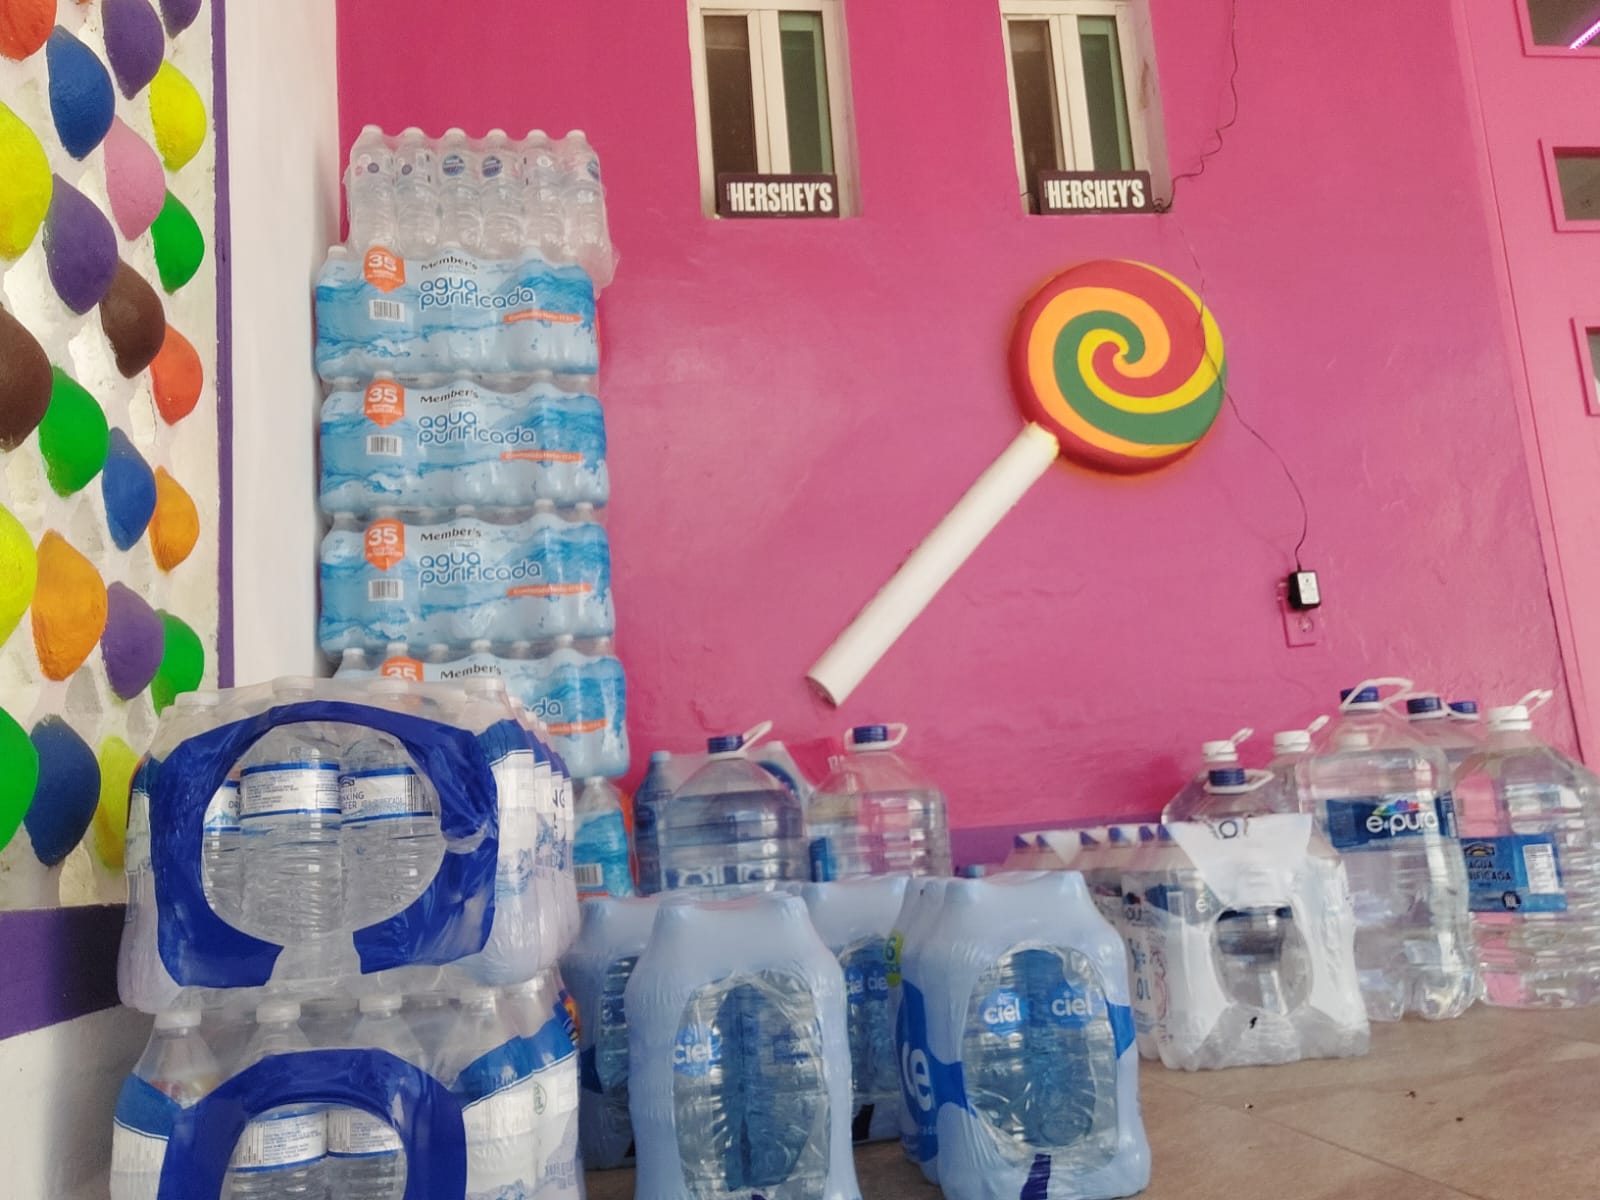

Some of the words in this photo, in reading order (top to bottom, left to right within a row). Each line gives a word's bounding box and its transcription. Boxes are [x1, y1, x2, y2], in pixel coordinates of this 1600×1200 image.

[729, 181, 834, 214] HERSHEY'S
[1047, 178, 1145, 208] HERSHEY'S
[368, 253, 397, 272] 35
[420, 255, 479, 271] Member's
[420, 277, 478, 296] agua
[420, 287, 535, 311] purificada
[367, 387, 398, 404] 35
[420, 389, 479, 404] Member's
[418, 411, 477, 434] agua
[418, 425, 536, 447] purificada
[367, 528, 399, 546] 35
[420, 528, 482, 542] Member's
[419, 551, 482, 574] agua
[420, 560, 542, 588] purificada
[440, 662, 502, 680] Member's
[983, 996, 1022, 1025] ciel
[1051, 990, 1093, 1017] ciel
[672, 1033, 714, 1064] ciel
